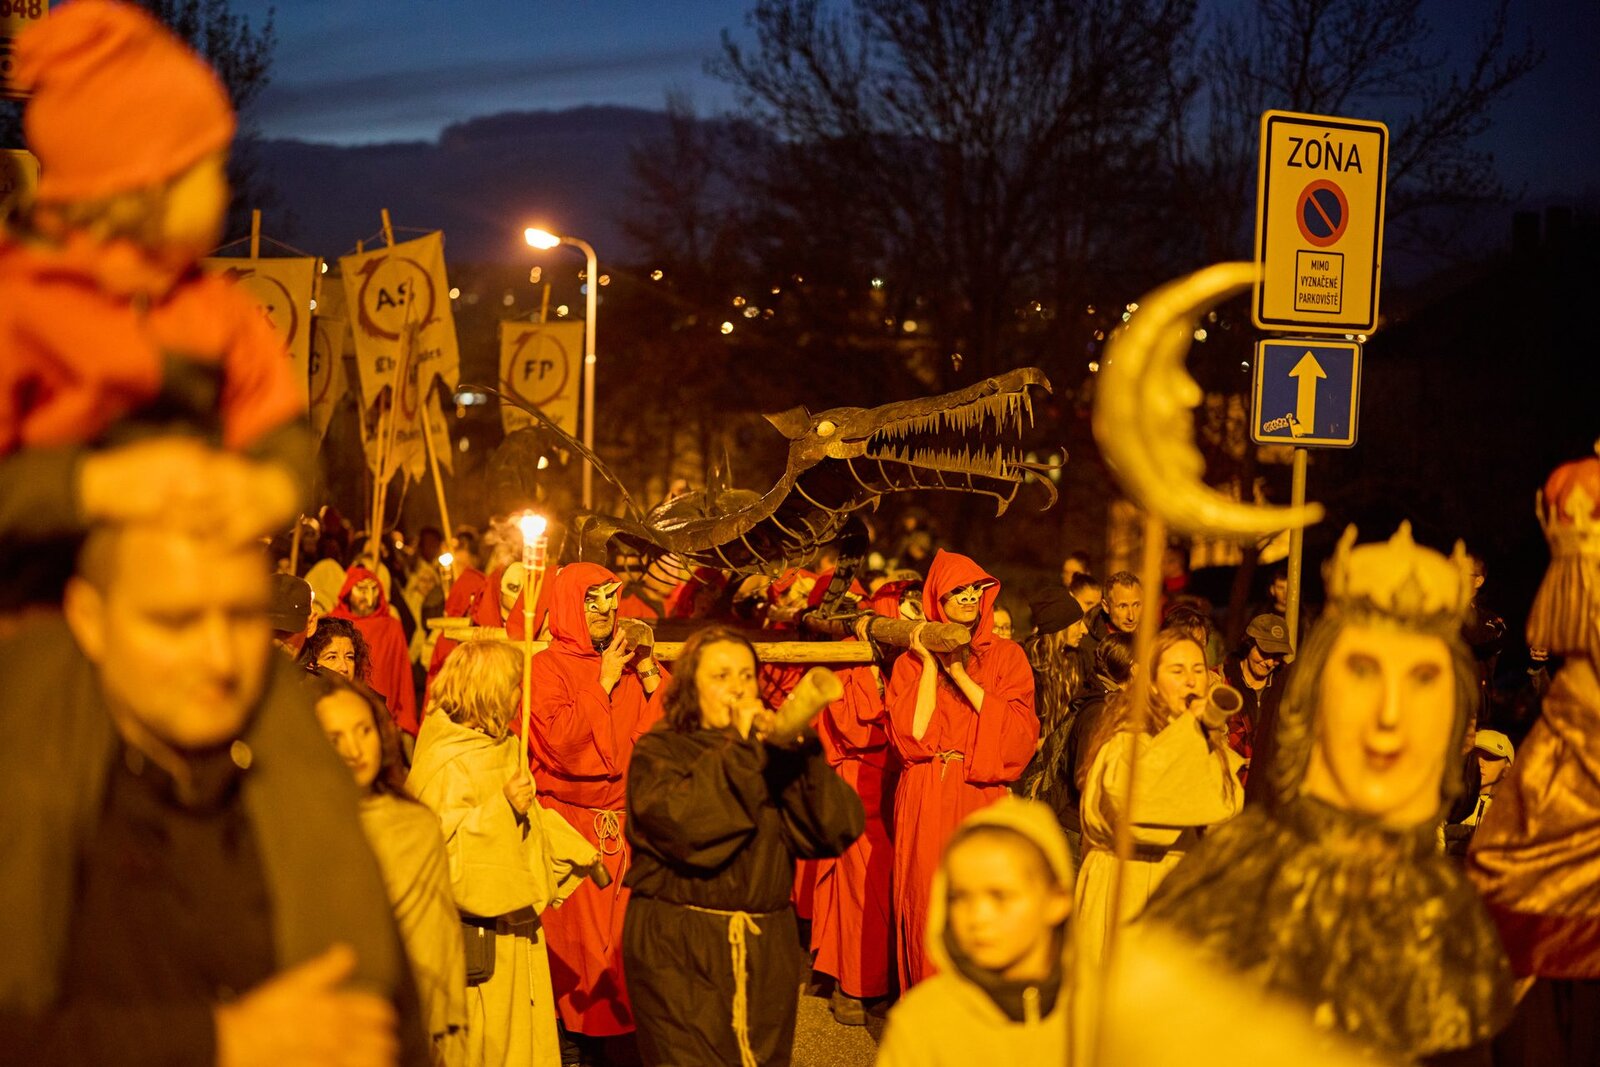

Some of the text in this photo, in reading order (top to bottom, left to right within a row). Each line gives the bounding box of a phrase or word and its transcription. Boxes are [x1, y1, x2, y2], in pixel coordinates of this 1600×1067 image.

[1311, 260, 1329, 271] MIMO
[1300, 274, 1338, 289] VYZNAČENÉ
[1298, 291, 1338, 306] PARKOVIŠTĚ
[524, 360, 554, 380] FP
